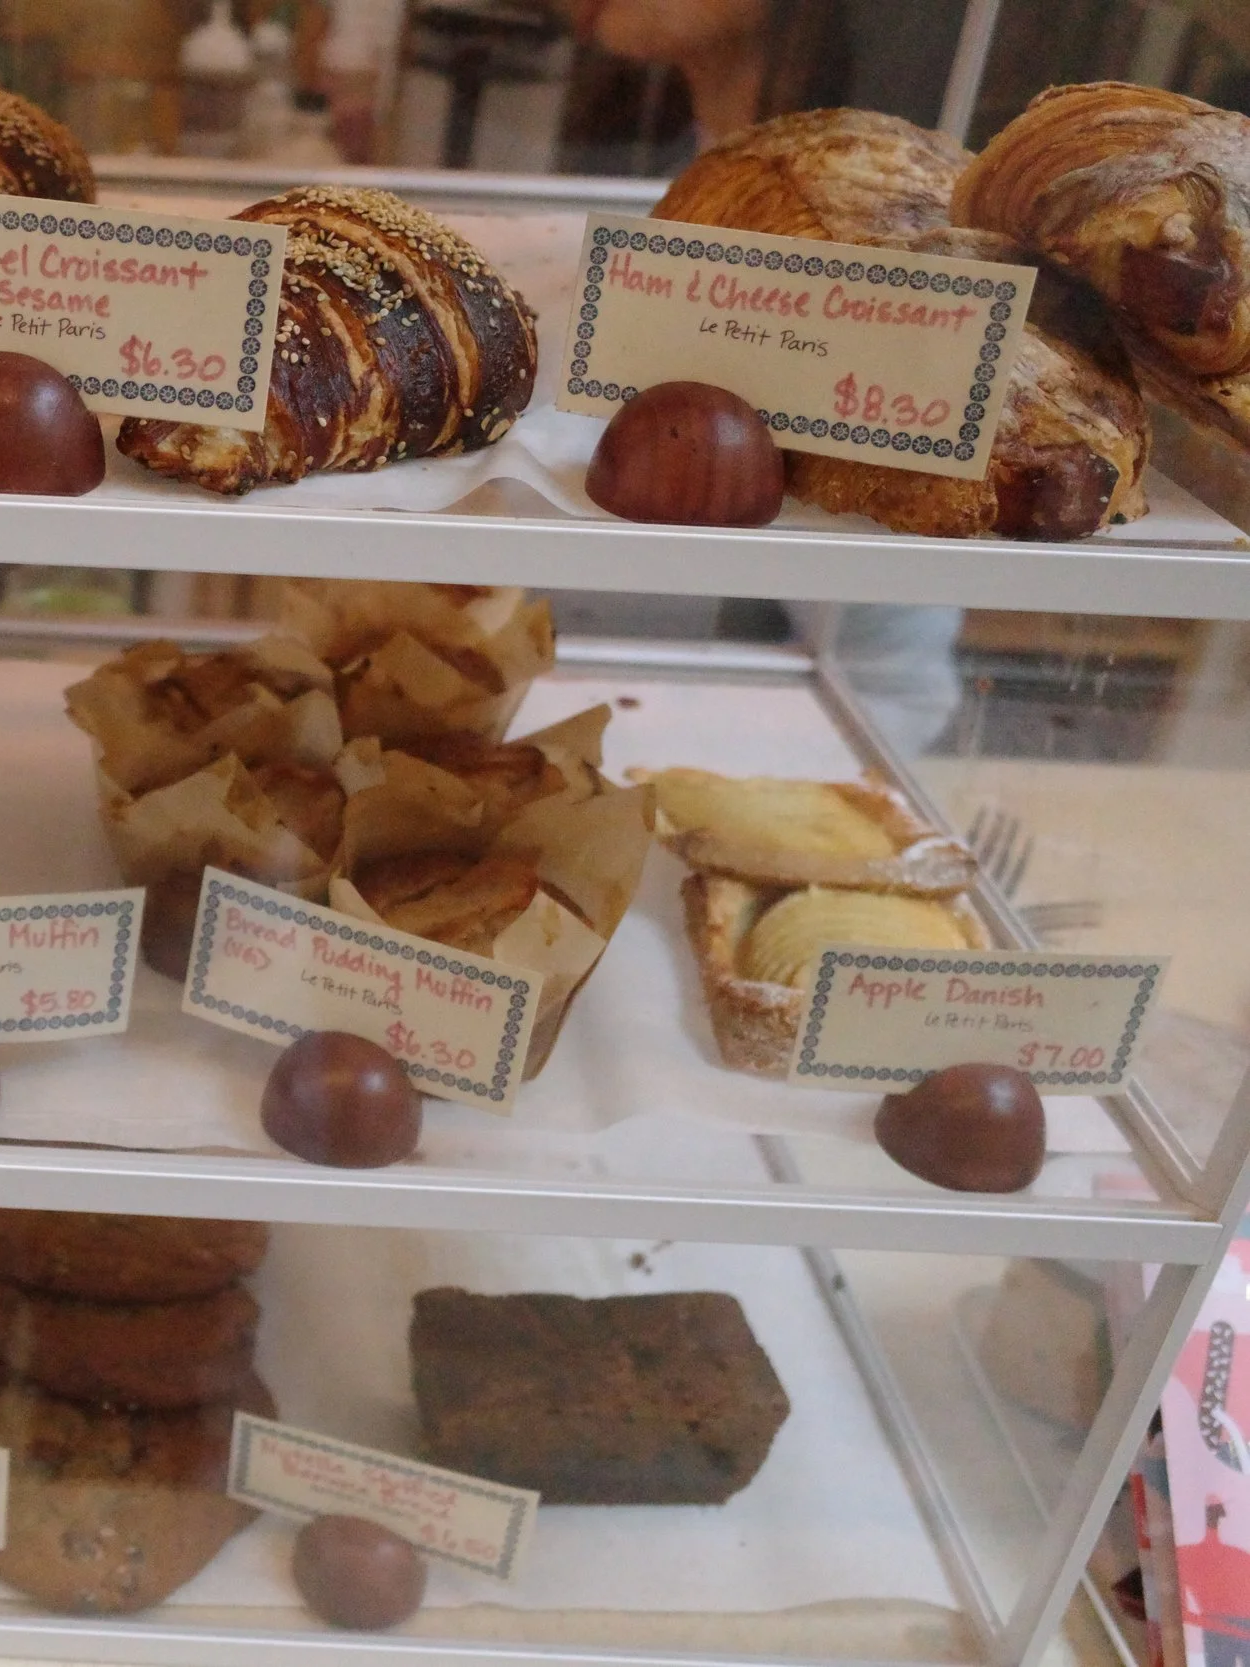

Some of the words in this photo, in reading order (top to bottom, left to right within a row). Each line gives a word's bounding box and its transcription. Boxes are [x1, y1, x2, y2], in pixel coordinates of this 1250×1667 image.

[39, 244, 209, 290] Croissant
[608, 251, 673, 298] Ham
[708, 274, 811, 319] Cheese
[822, 284, 979, 331] Croissant
[11, 314, 52, 338] Petit
[58, 318, 106, 341] Paris
[699, 317, 718, 335] Le
[724, 320, 771, 345] Petit
[780, 330, 828, 357] Paris
[119, 334, 227, 382] $6.30
[833, 372, 949, 428] $8.30
[8, 917, 101, 950] Muffin
[226, 907, 296, 949] Bread
[312, 935, 403, 999] Pudding
[415, 967, 493, 1012] Muffin
[301, 968, 318, 986] Le
[321, 975, 357, 1000] Petit
[362, 988, 403, 1015] Paris
[849, 973, 927, 1009] Apple
[945, 977, 1044, 1008] Danish
[385, 1020, 476, 1070] $6.30
[1018, 1042, 1105, 1070] $7.00
